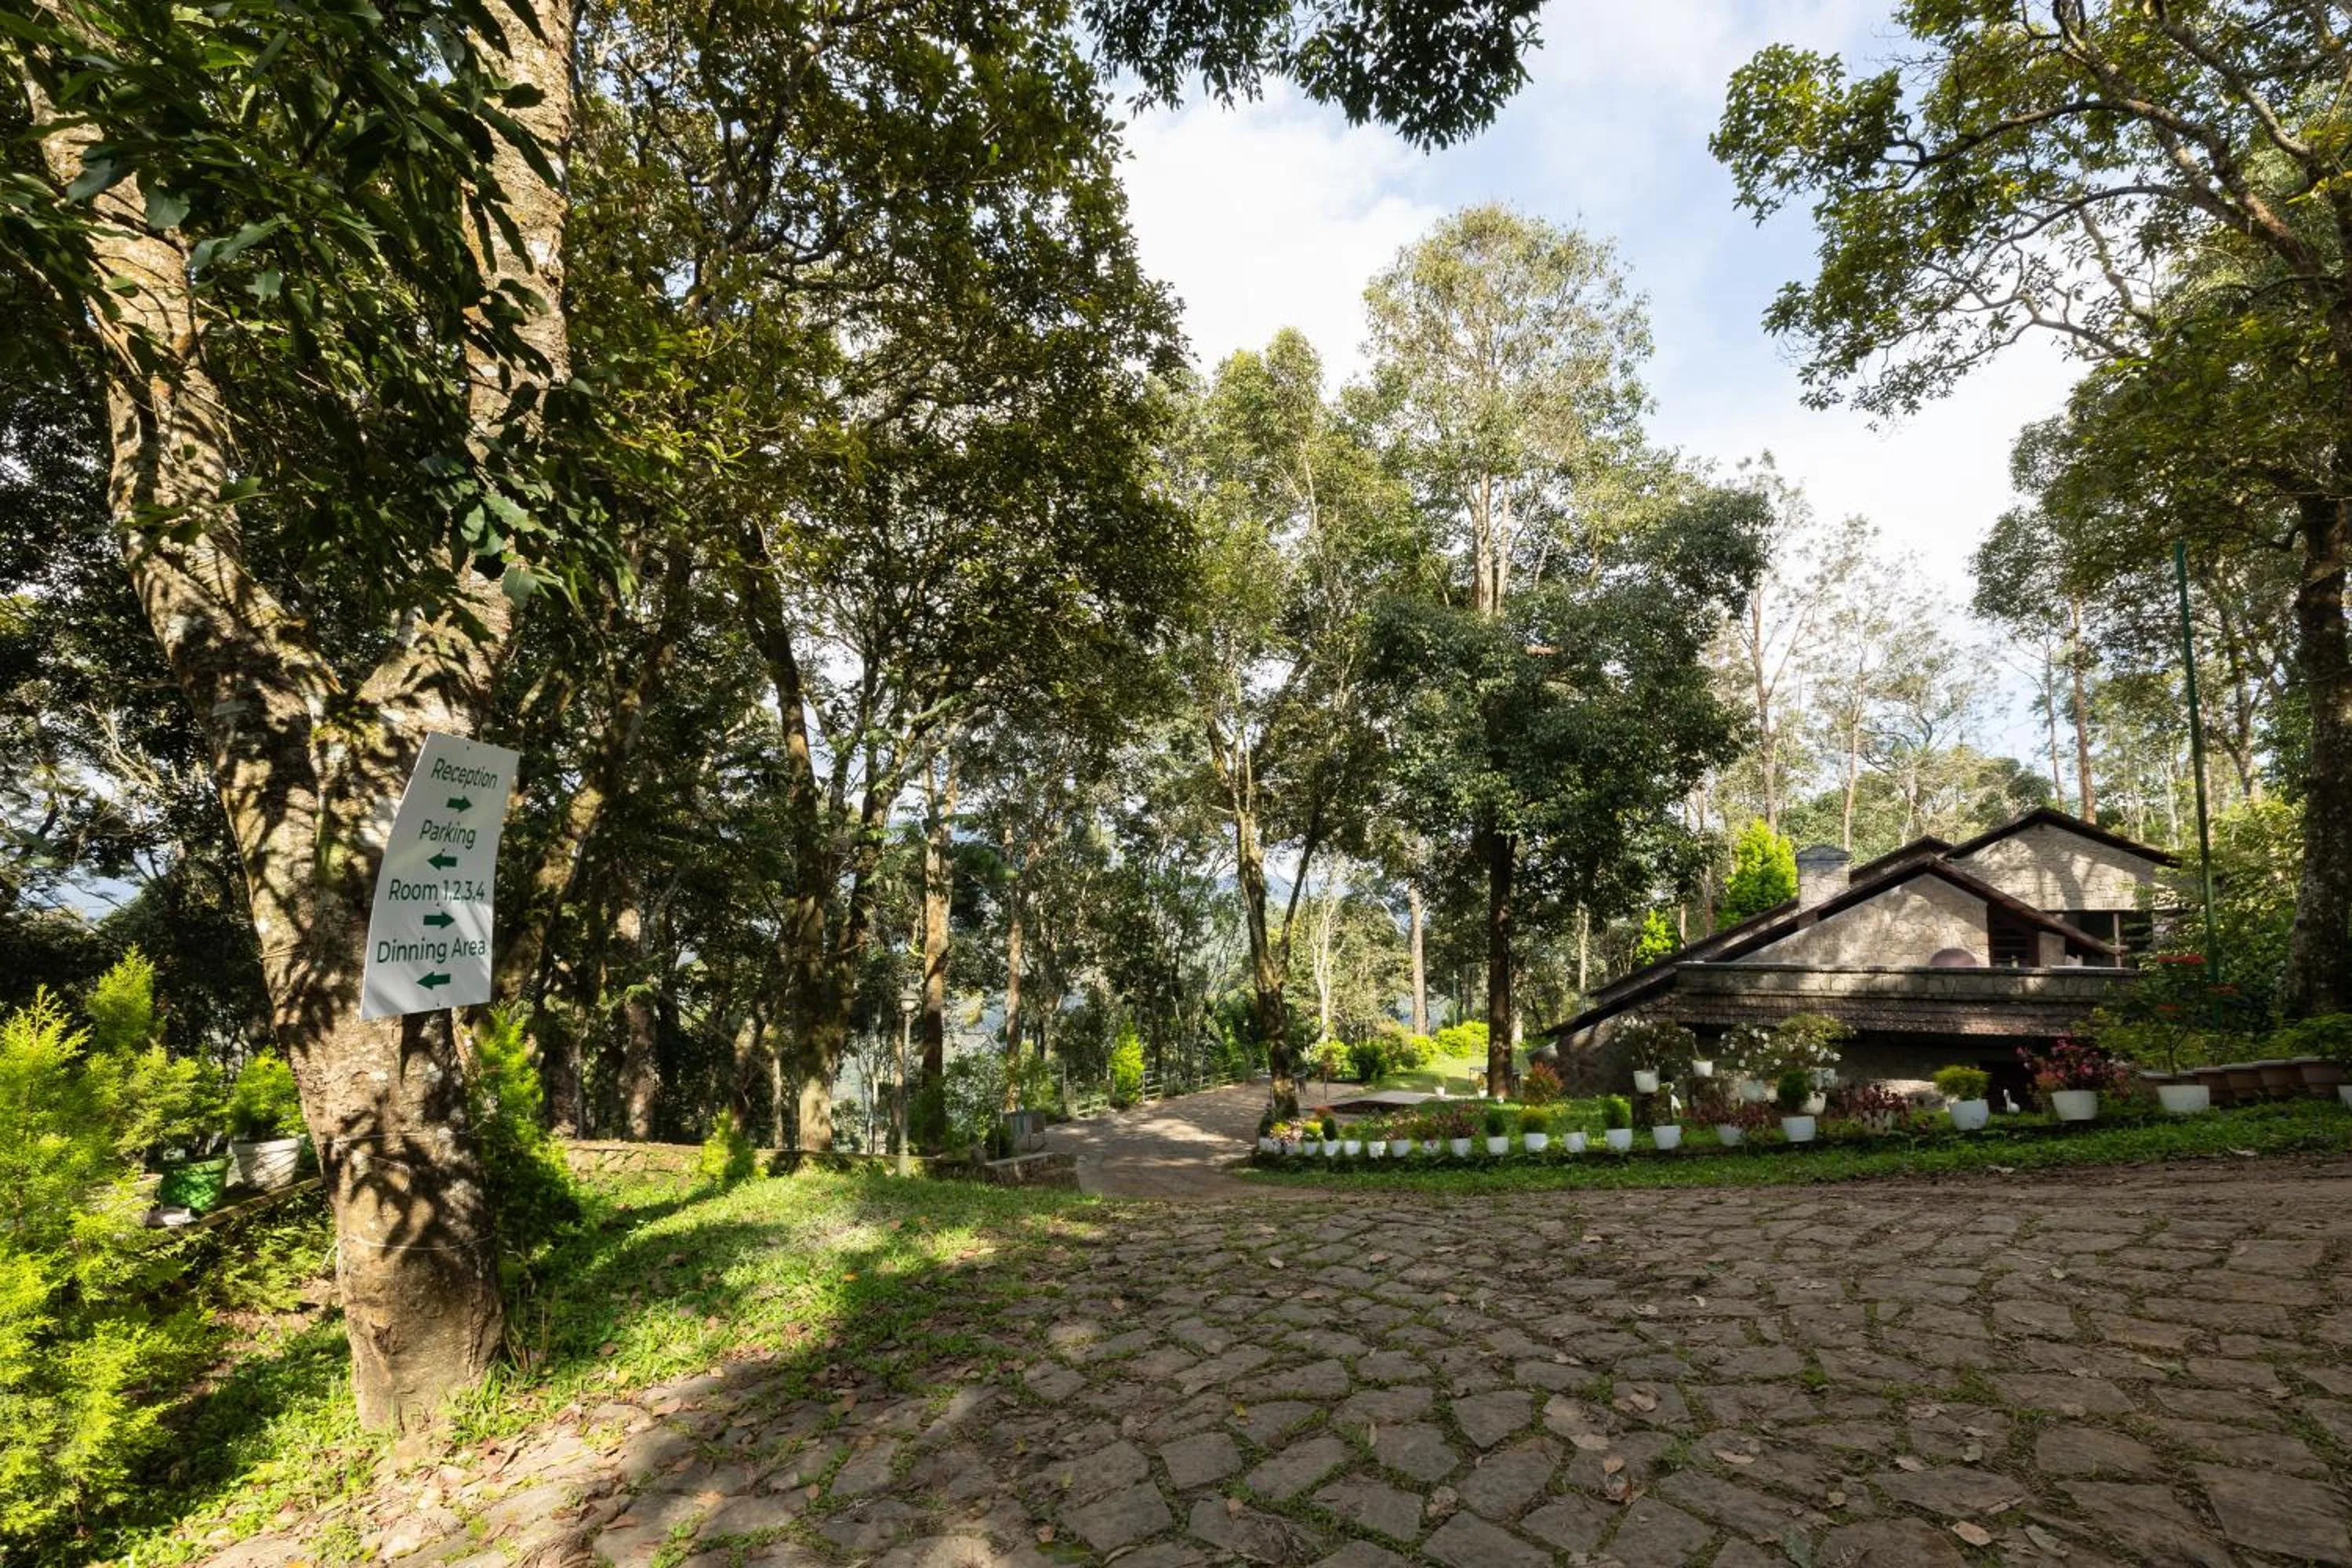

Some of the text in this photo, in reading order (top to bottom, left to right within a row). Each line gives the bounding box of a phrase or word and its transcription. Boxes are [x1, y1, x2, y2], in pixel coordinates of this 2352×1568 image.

[431, 758, 498, 789] Reception
[419, 820, 477, 849] Parking
[389, 879, 438, 902] Room
[376, 937, 486, 964] Dinning Area
